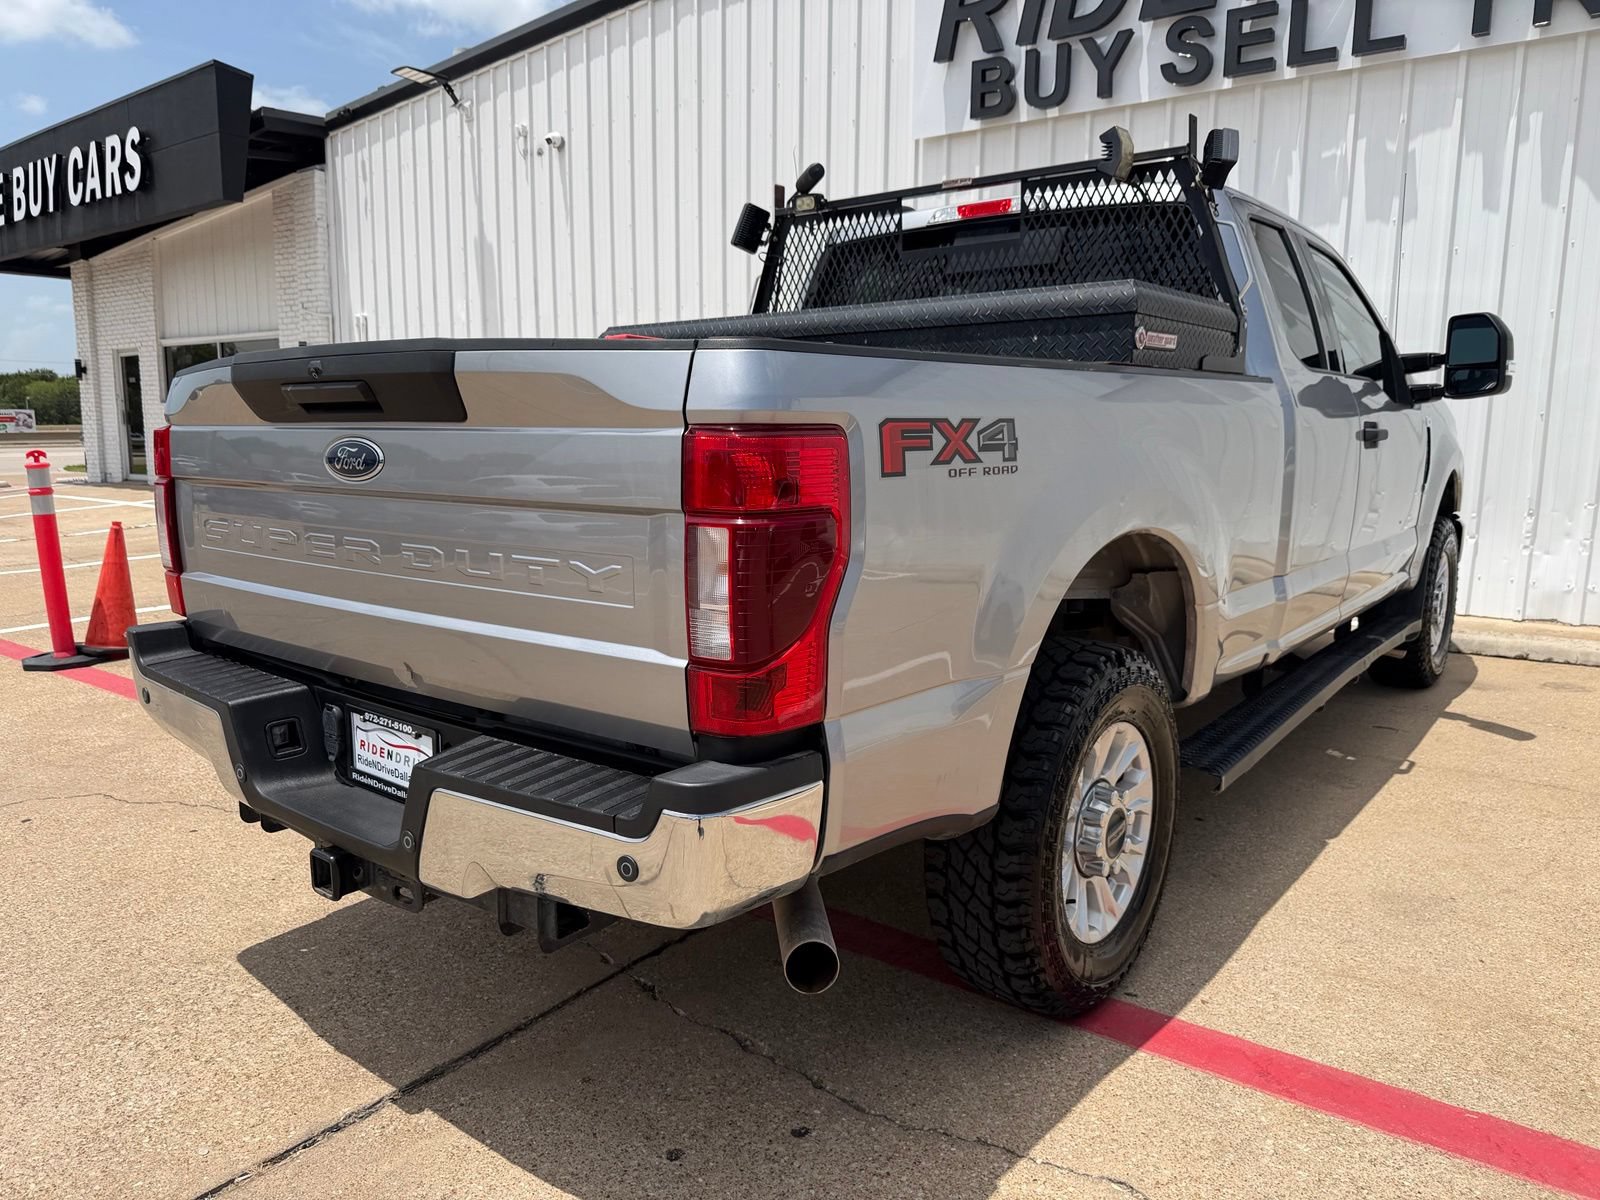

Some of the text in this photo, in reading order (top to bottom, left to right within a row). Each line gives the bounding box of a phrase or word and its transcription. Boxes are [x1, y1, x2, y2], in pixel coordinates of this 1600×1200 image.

[970, 28, 1134, 120] BUY
[1160, 0, 1407, 87] SELL
[12, 152, 58, 223] BUY
[67, 126, 142, 207] CARS
[334, 446, 366, 470] Ford
[879, 417, 1019, 478] FX4
[948, 465, 1018, 478] OFF ROAD
[203, 519, 623, 594] SUPER DUTY
[364, 712, 413, 735] 972-271-5100
[357, 753, 411, 783] RideNDriveDalla
[359, 739, 421, 767] RIDENDRI
